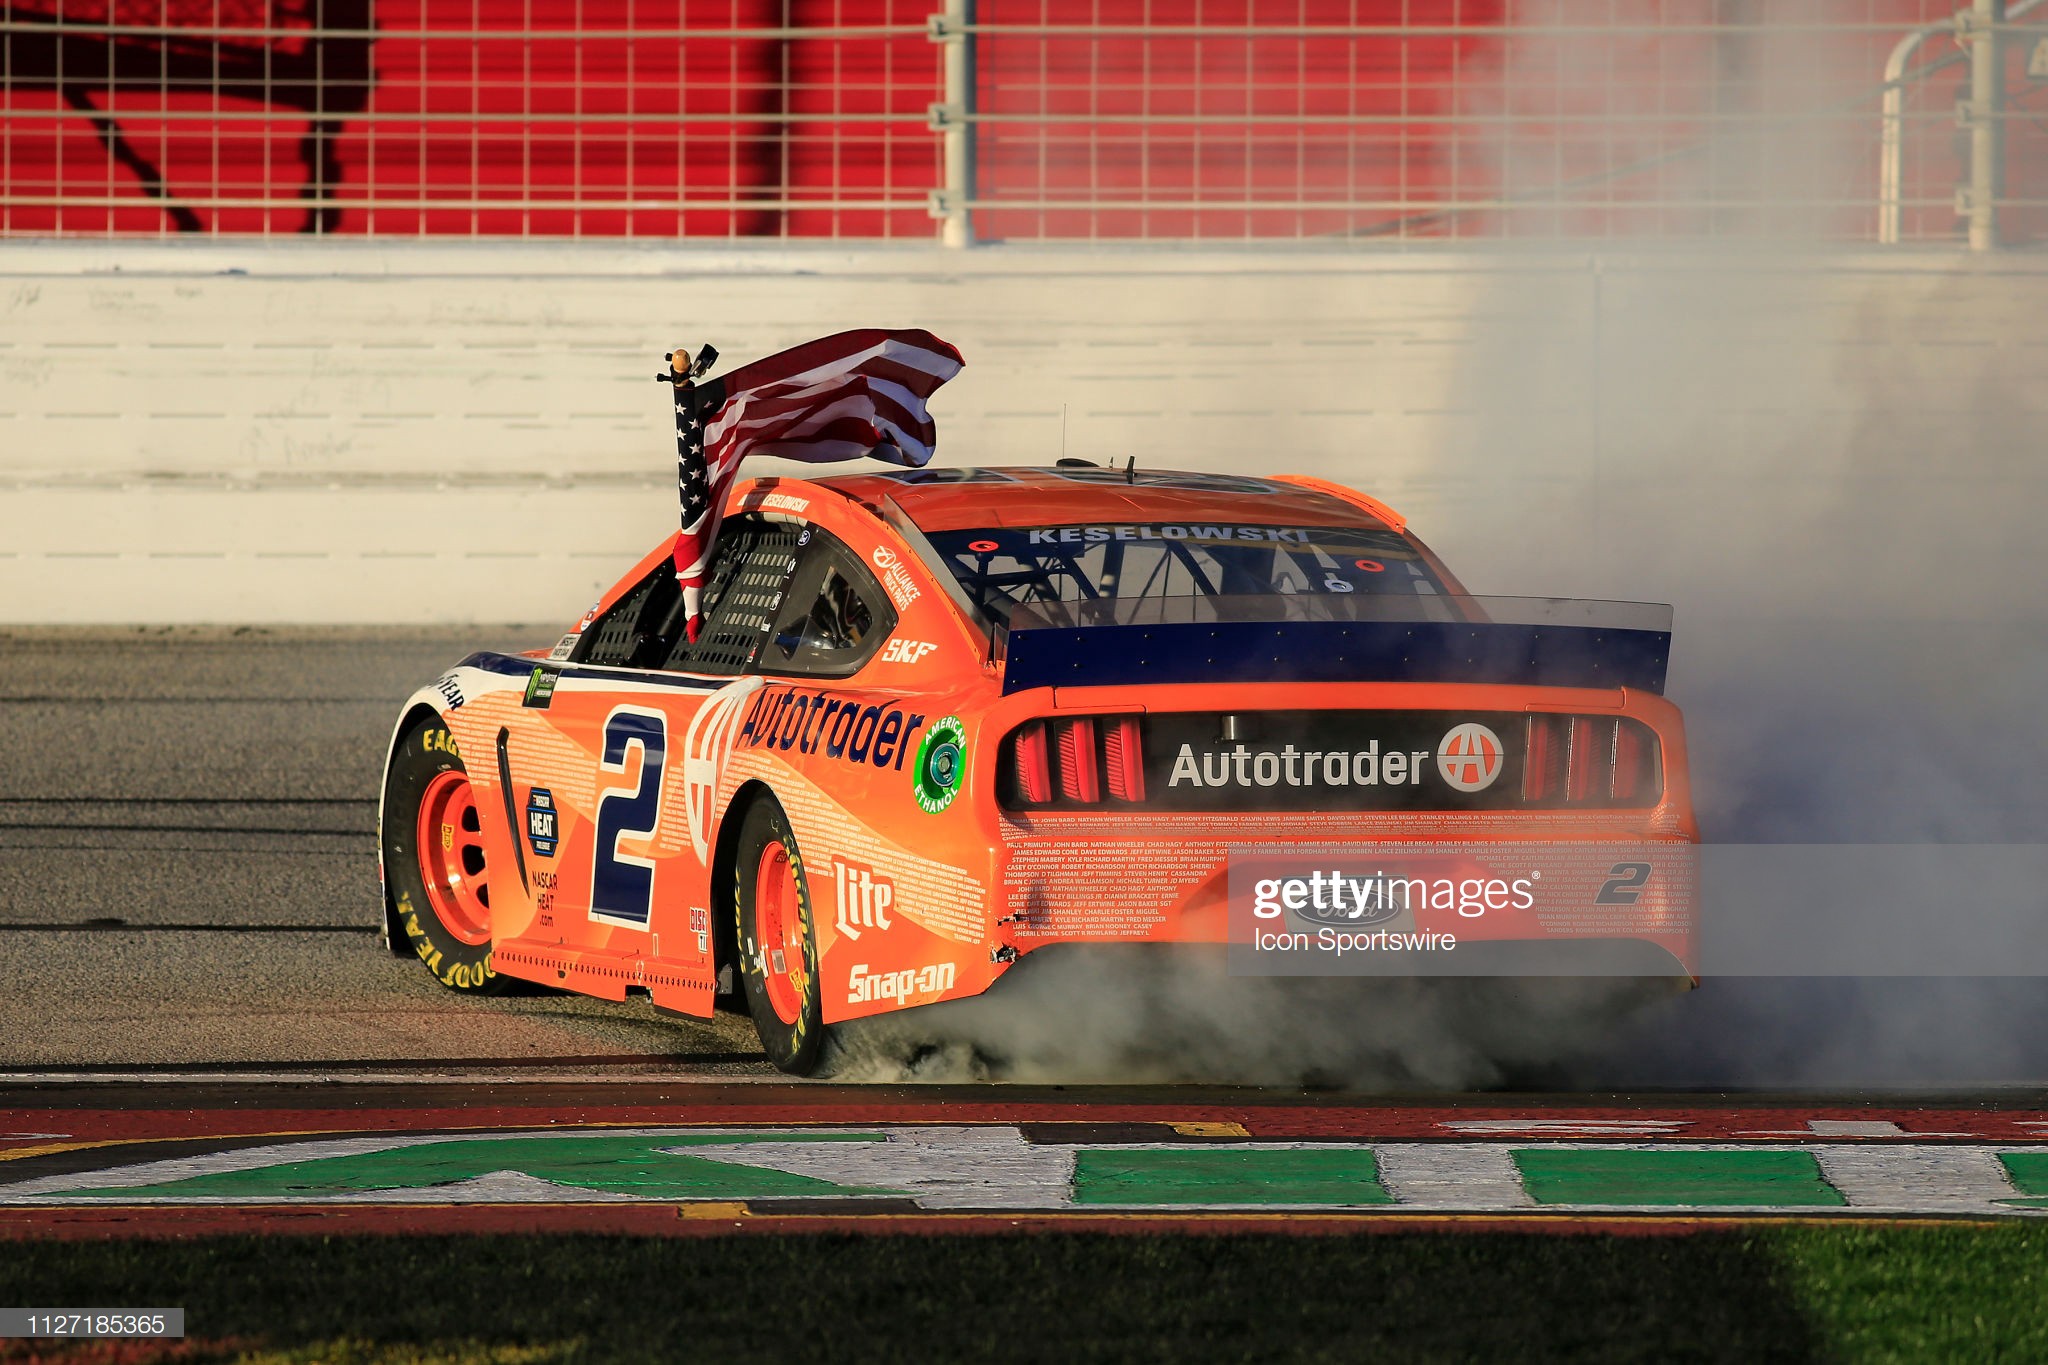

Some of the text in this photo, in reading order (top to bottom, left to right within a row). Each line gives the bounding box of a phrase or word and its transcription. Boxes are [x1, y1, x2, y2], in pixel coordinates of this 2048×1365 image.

[1030, 526, 1309, 544] KESELOWSKI
[883, 570, 909, 611] TRUCK PARTS
[890, 562, 921, 602] ALLIANCE
[882, 638, 938, 664] SKF
[423, 729, 461, 758] EAG
[736, 687, 925, 771] Autotrader
[926, 717, 966, 750] AMERICAN
[1168, 740, 1429, 787] Autotrader
[914, 784, 958, 813] ETHANOL
[531, 812, 553, 837] HEAT
[589, 704, 667, 931] 2
[532, 871, 557, 891] NASCAR
[1593, 861, 1653, 905] 2
[538, 894, 554, 911] HEAT
[834, 862, 892, 941] Lite
[848, 962, 955, 1005] Snap-on
